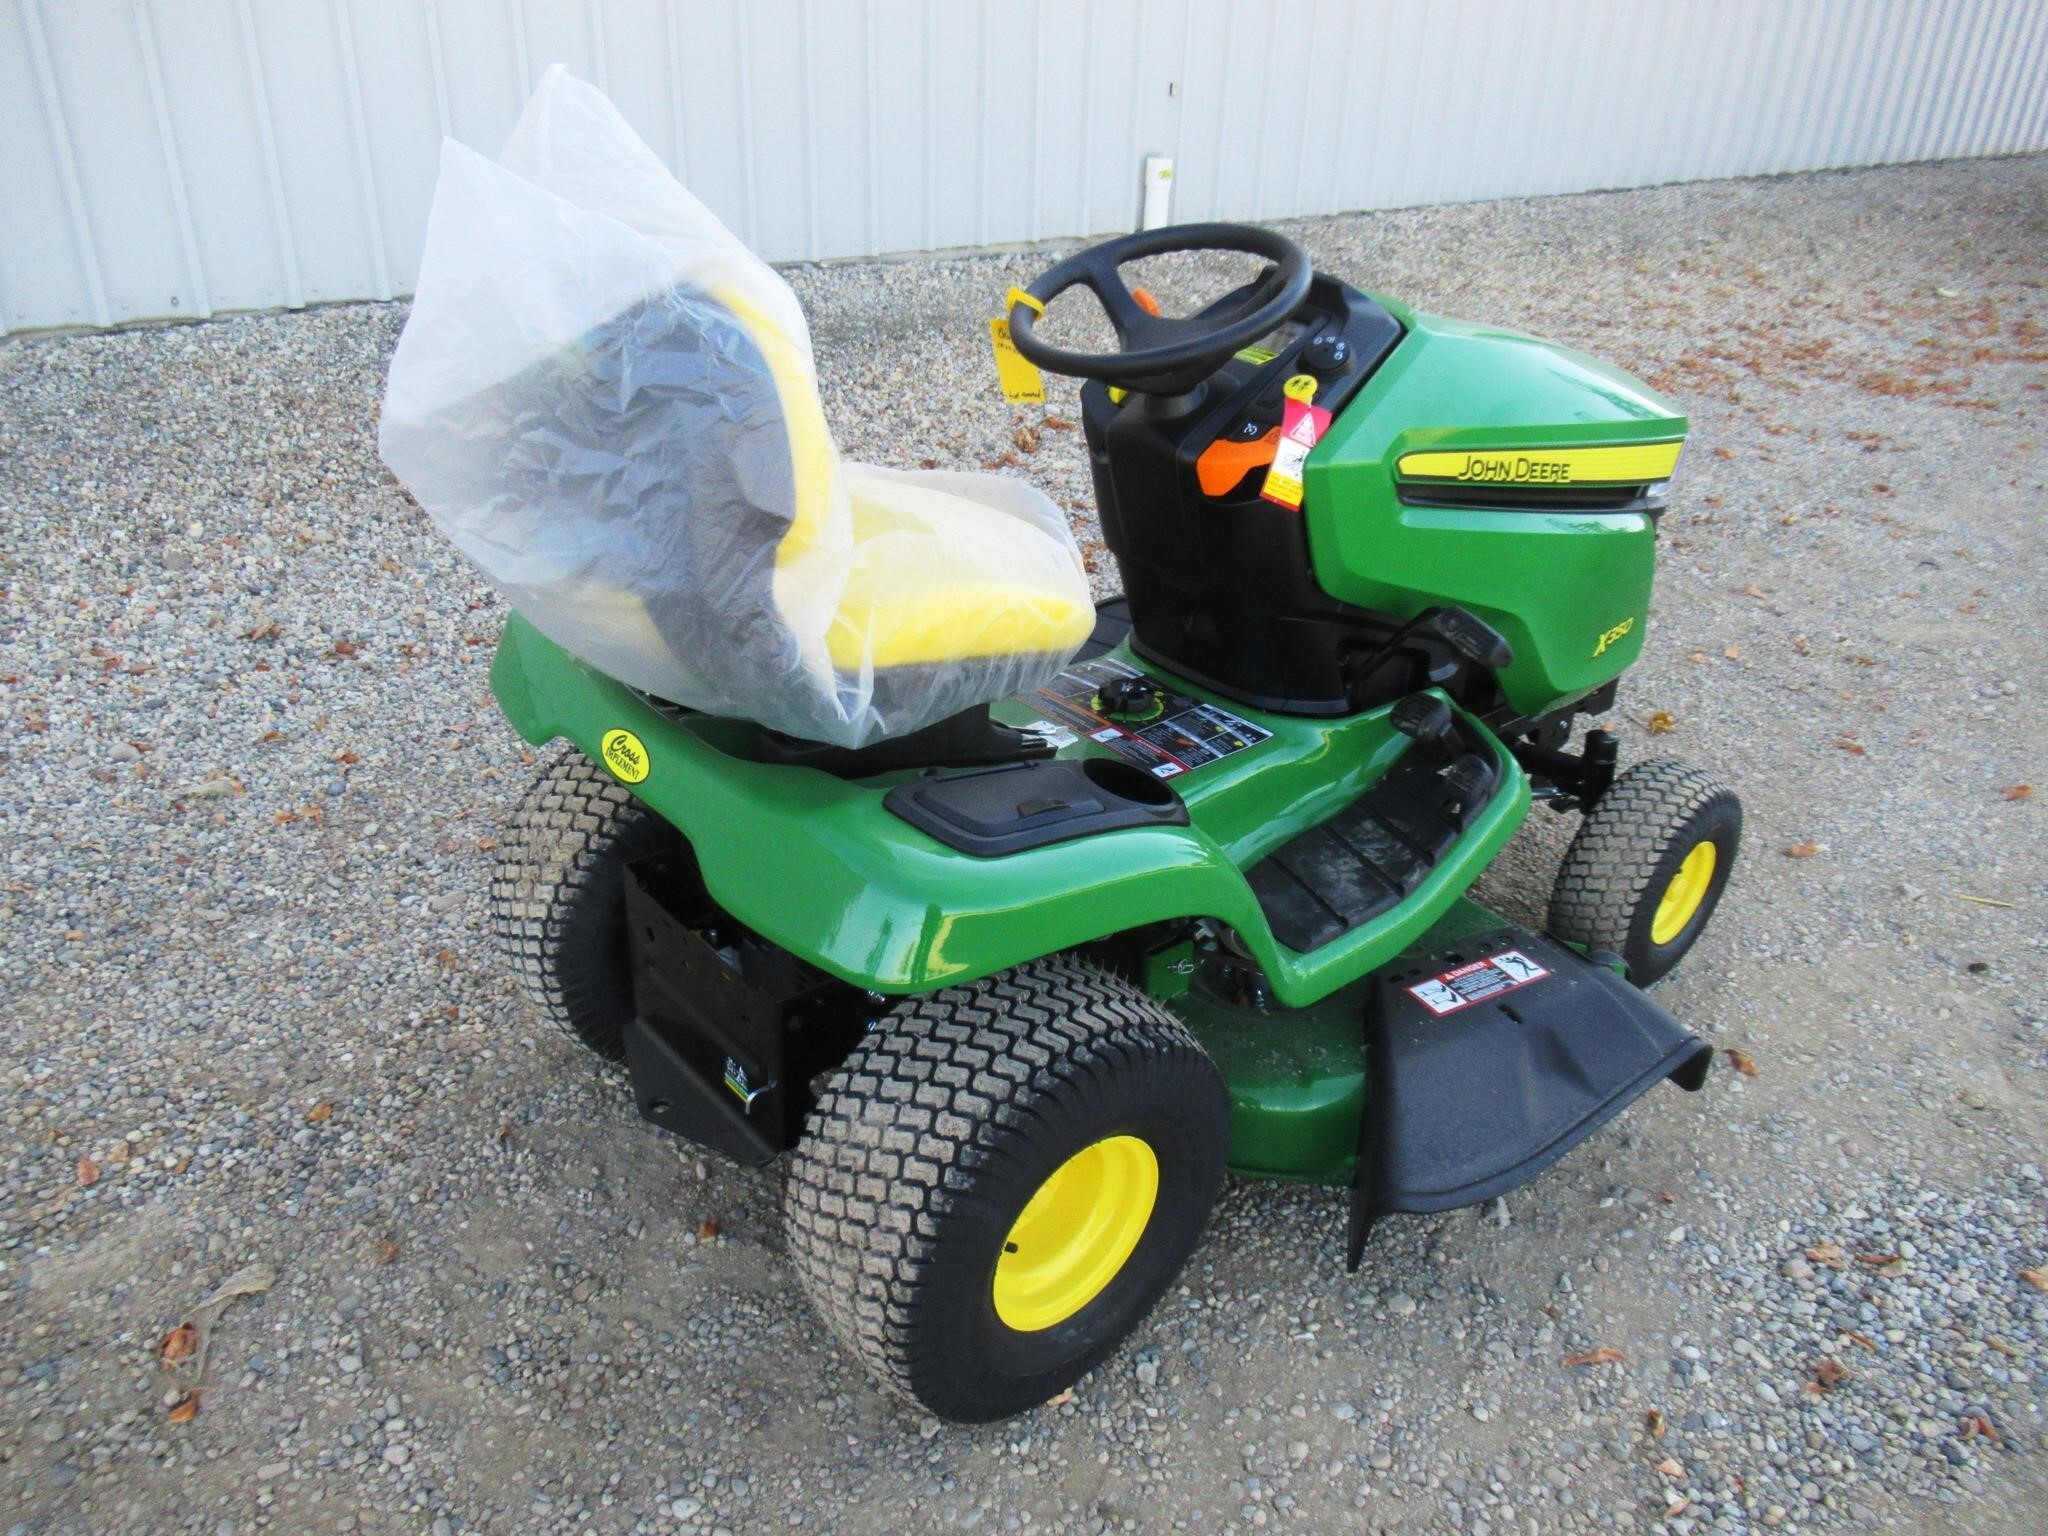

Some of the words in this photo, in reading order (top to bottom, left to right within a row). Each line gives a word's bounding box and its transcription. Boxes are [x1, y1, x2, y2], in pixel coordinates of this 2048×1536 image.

[1459, 456, 1511, 479] JOHN
[1516, 458, 1571, 480] DEERE
[611, 735, 641, 765] Cross
[1451, 960, 1487, 977] DANGER
